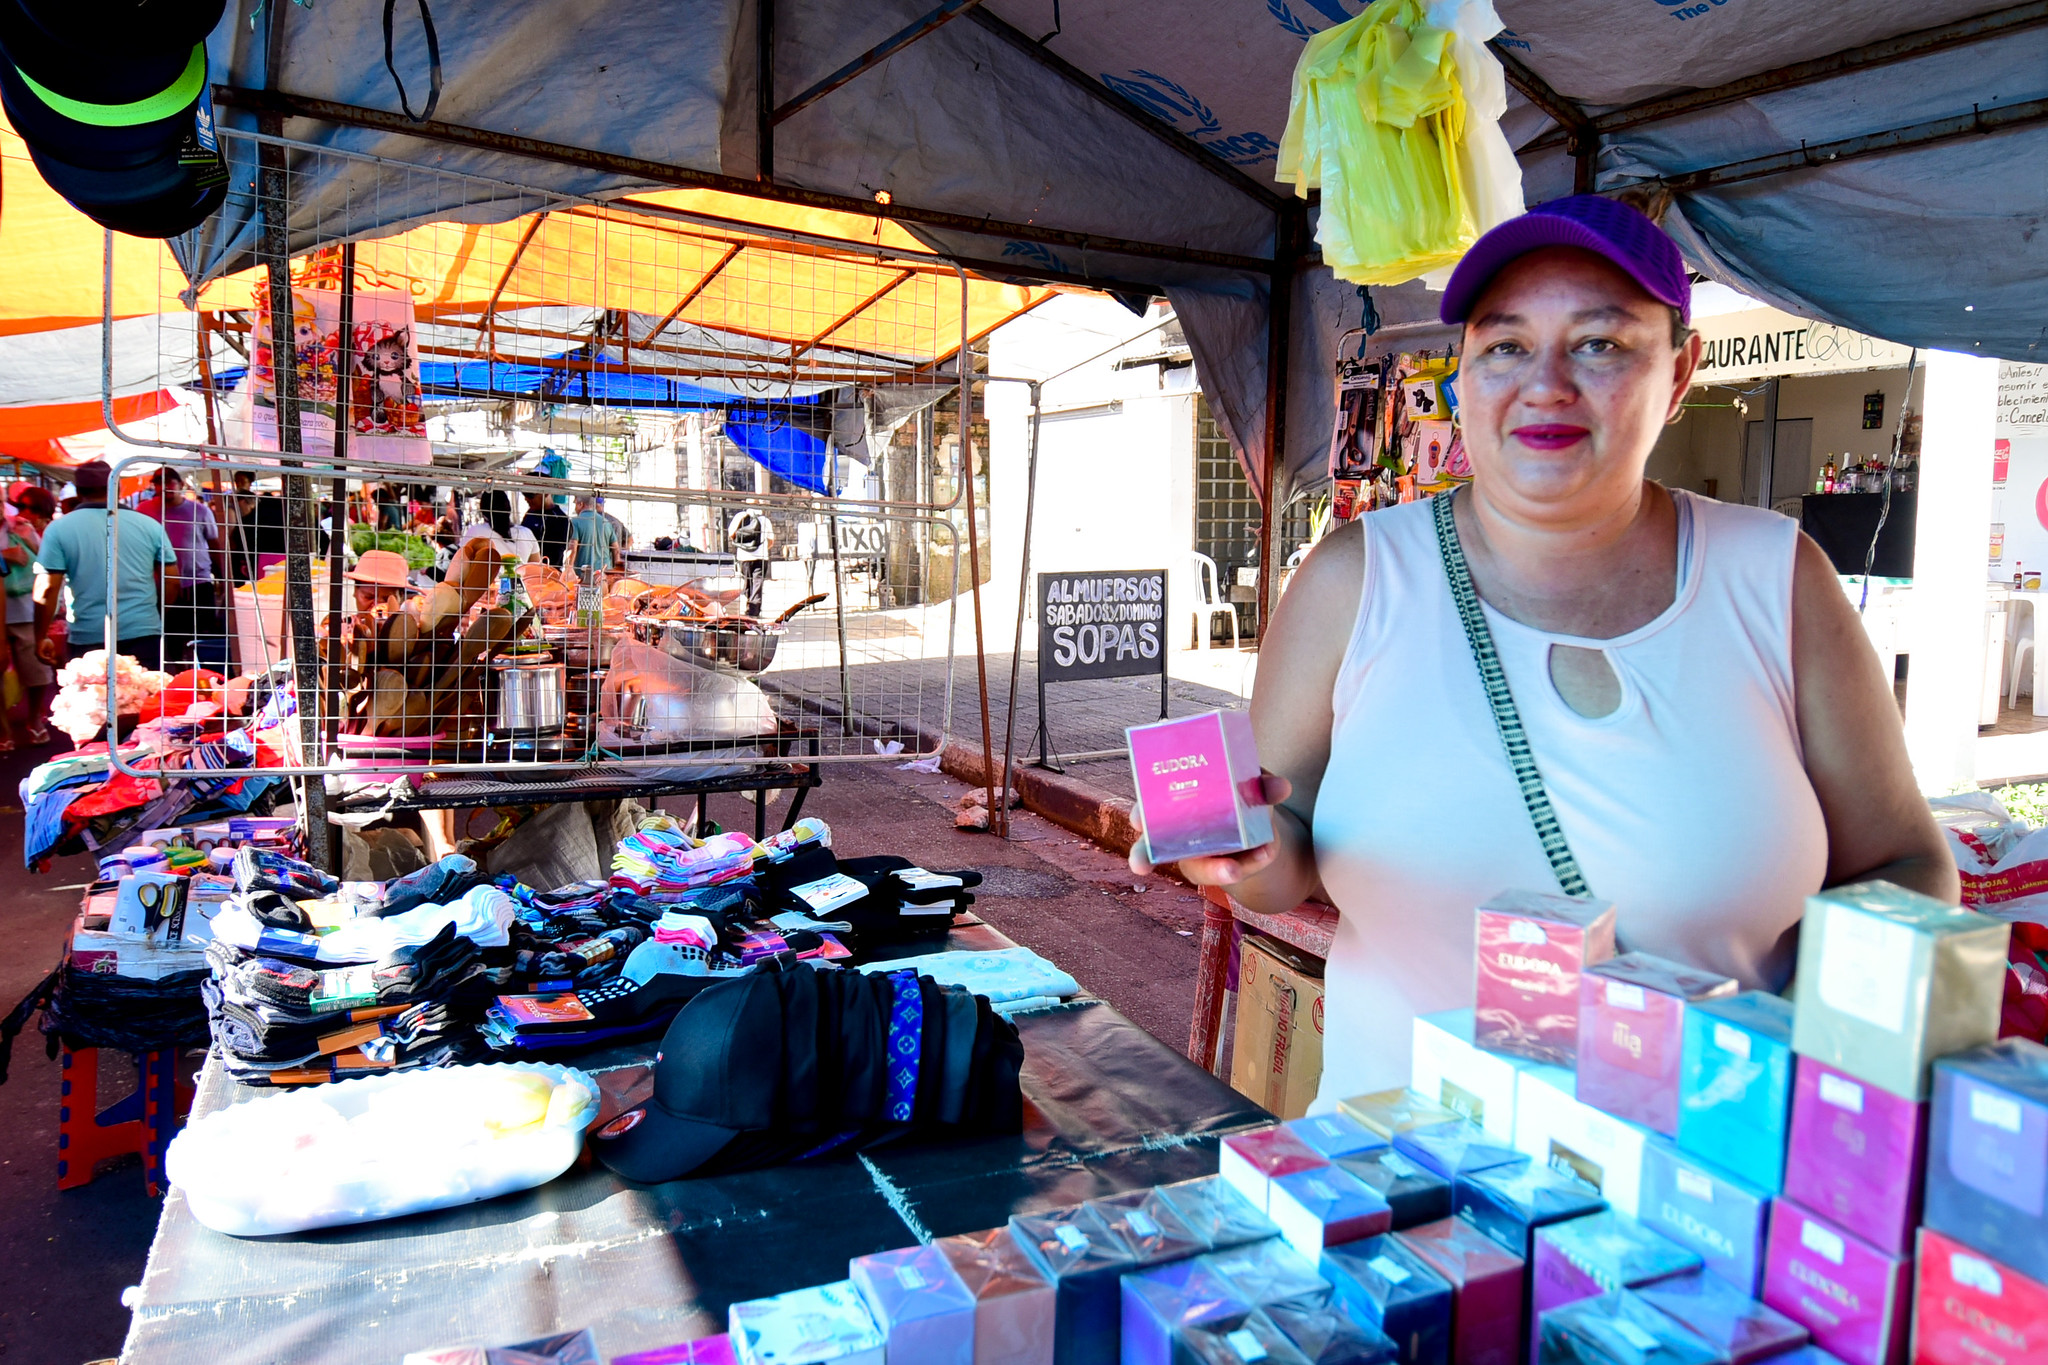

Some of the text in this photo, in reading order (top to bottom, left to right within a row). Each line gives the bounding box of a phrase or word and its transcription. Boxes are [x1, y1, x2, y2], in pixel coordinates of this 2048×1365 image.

[1670, 3, 1710, 21] The
[1200, 131, 1280, 159] HCR
[2009, 406, 2048, 424] Cancel
[1046, 576, 1163, 603] ALMUERSOS
[1053, 622, 1160, 667] SOPAS
[1152, 753, 1208, 775] EUDORA
[1498, 952, 1562, 976] EUDORA
